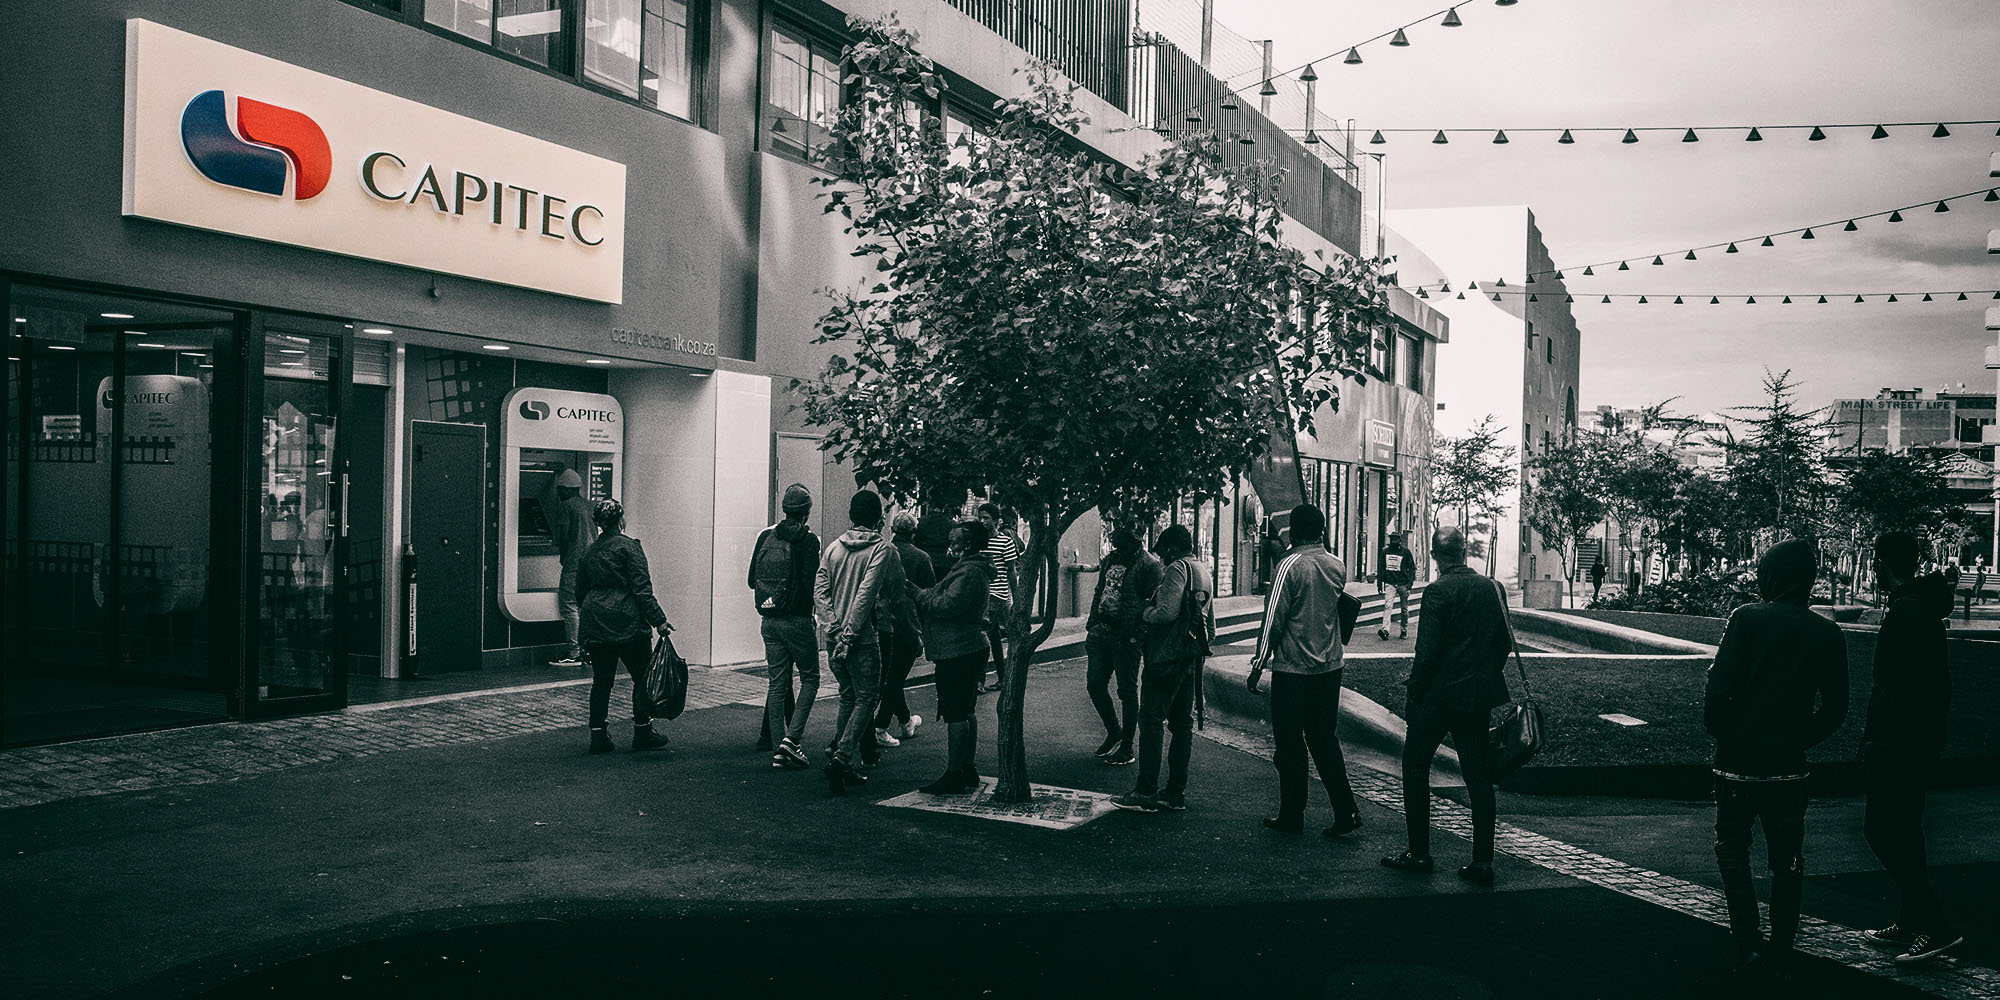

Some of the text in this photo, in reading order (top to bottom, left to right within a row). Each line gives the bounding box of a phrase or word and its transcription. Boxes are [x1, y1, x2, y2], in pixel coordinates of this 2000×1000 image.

[362, 151, 605, 246] CAPITEC
[611, 327, 716, 356] capitecbank.co.za
[557, 407, 616, 423] CAPITEC
[1841, 401, 1950, 409] MAN STREET LIFE
